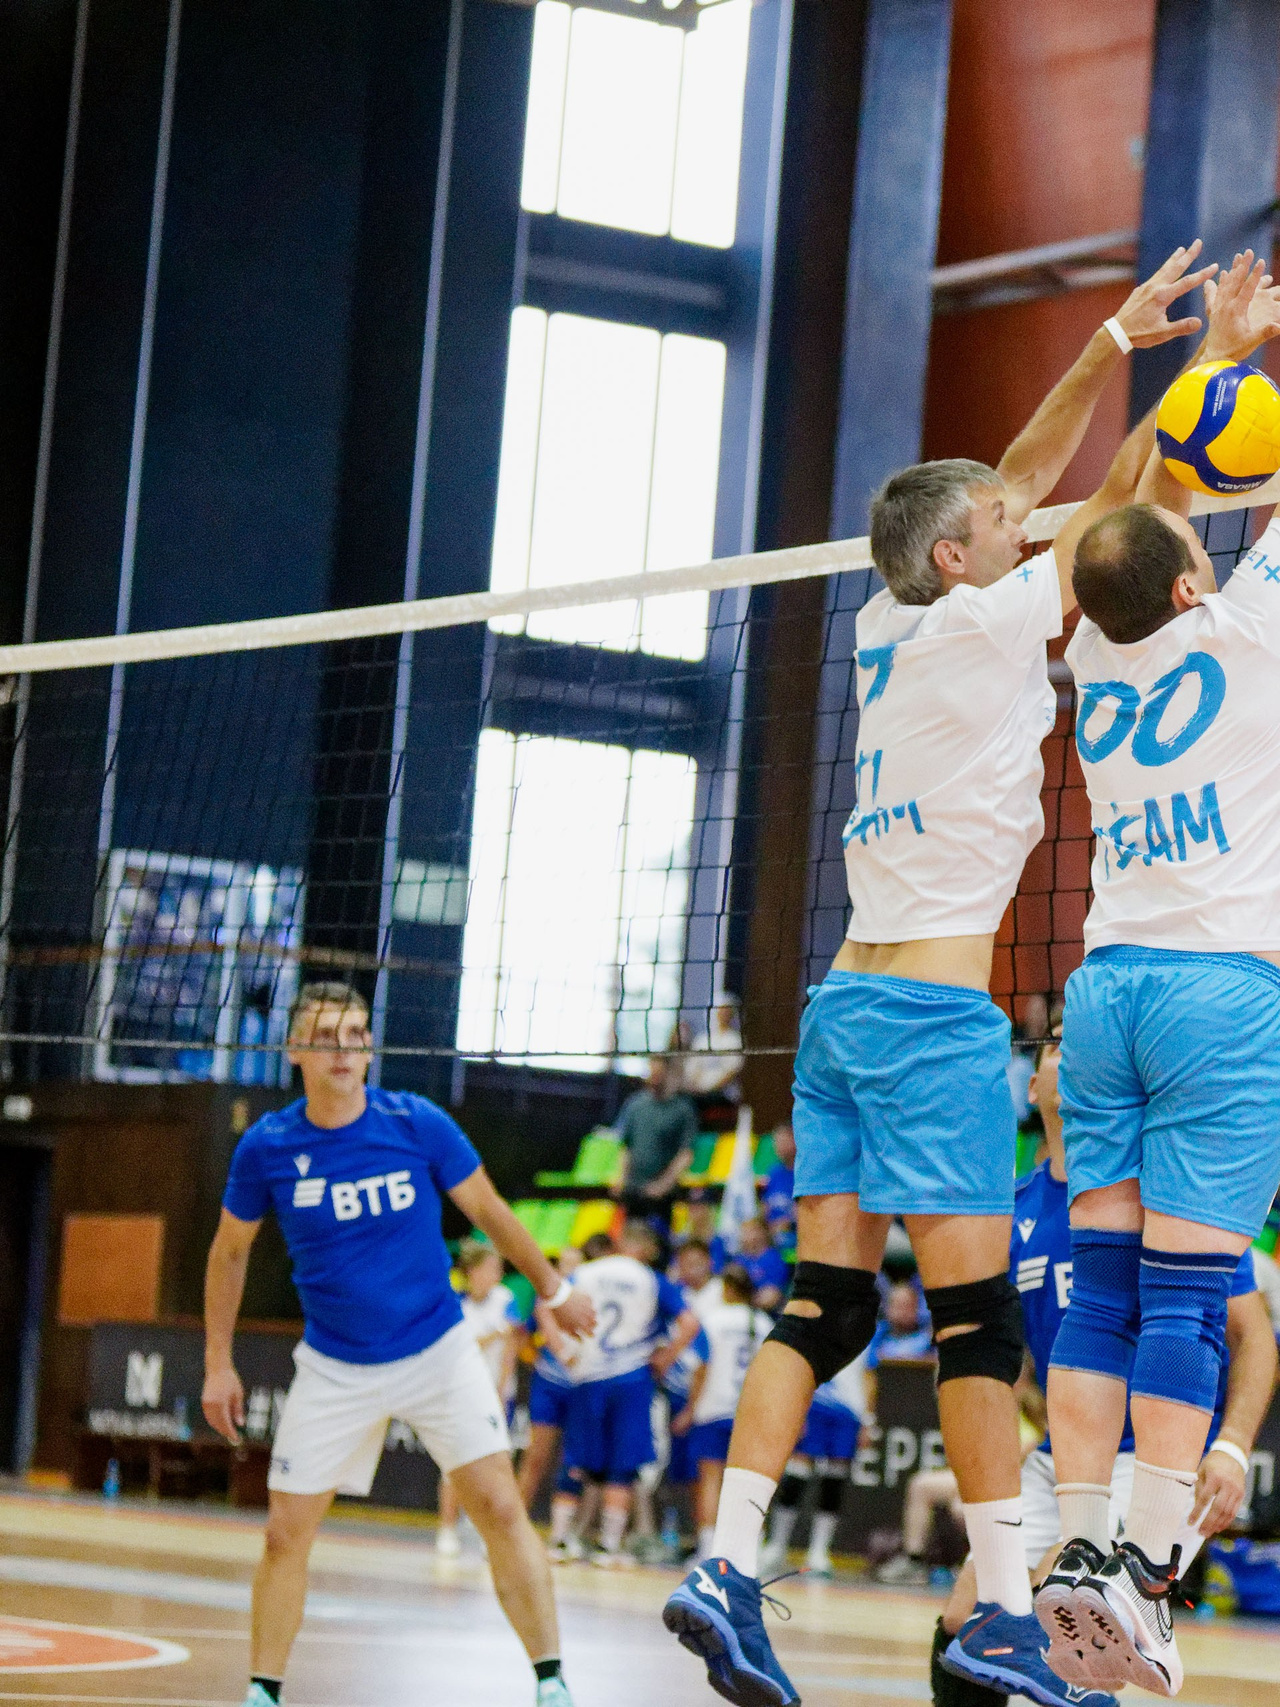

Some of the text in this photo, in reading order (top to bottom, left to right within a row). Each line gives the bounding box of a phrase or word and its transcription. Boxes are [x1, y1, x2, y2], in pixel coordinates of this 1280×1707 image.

[1217, 481, 1263, 491] MIKASA
[1075, 651, 1227, 767] 00
[331, 1170, 416, 1222] ВТБ
